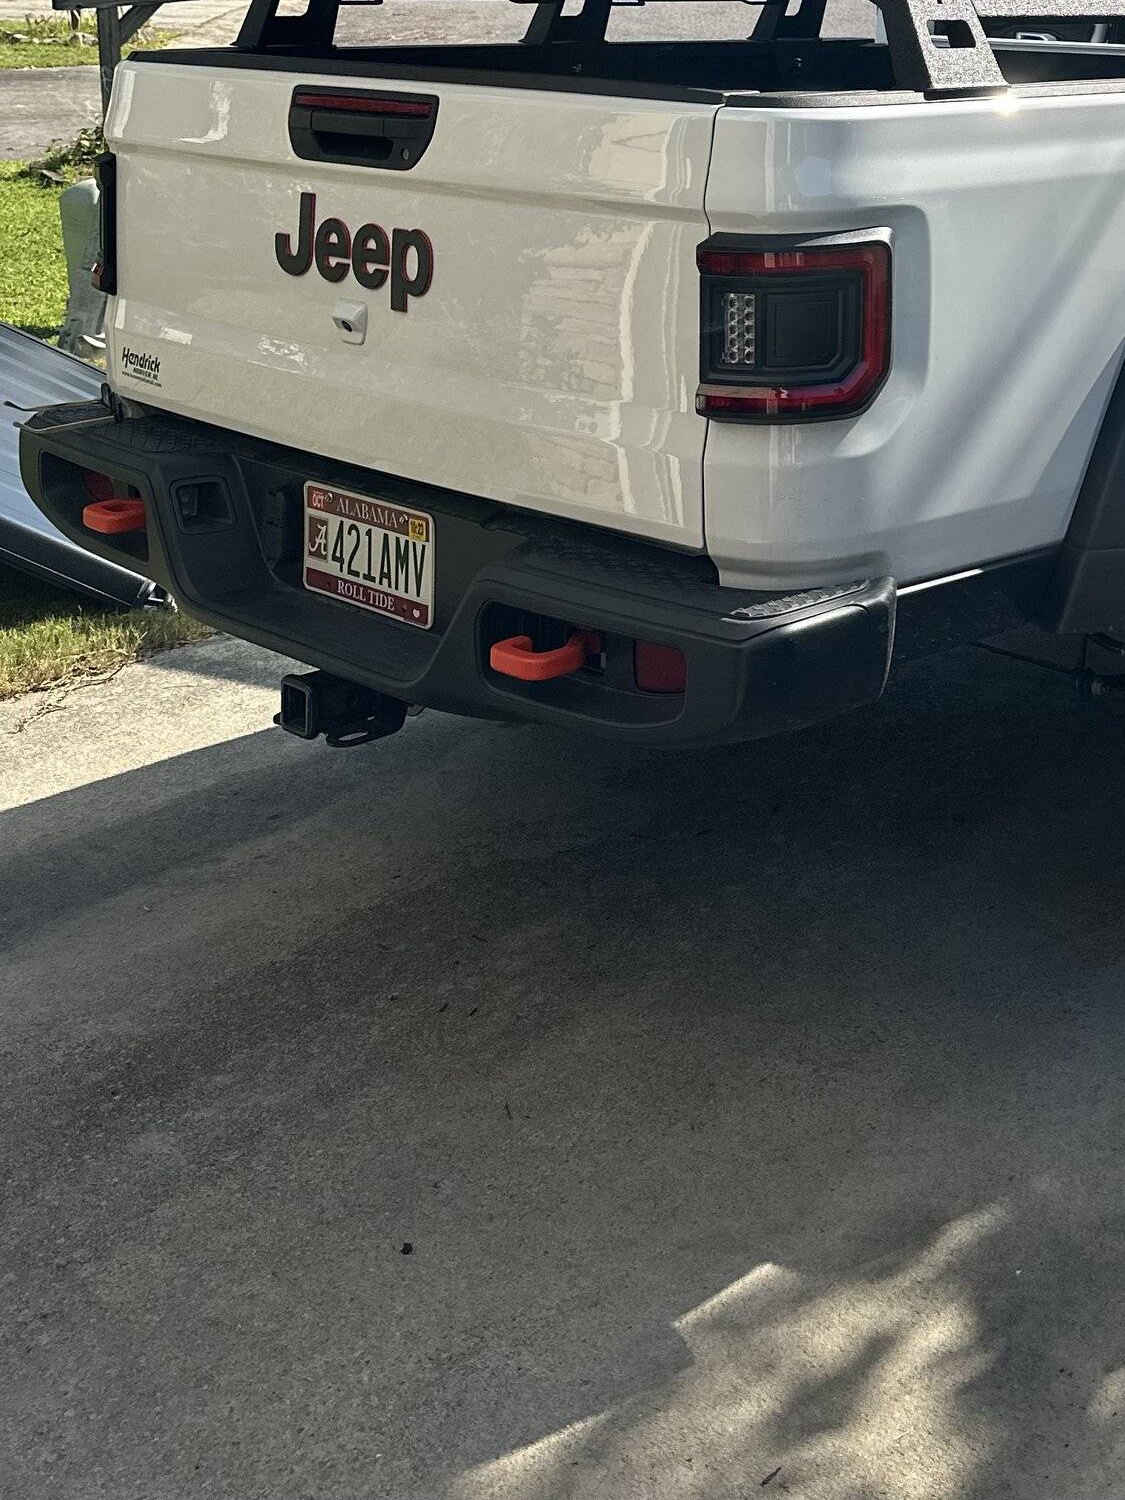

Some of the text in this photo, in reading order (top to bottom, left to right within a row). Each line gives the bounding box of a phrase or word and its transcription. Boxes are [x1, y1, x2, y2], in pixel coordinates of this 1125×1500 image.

[275, 191, 434, 313] Jeep
[122, 346, 160, 372] Hendrick
[336, 498, 398, 528] ALABAMA
[331, 520, 426, 598] 421AMV
[337, 580, 395, 610] ROLL TIDE
